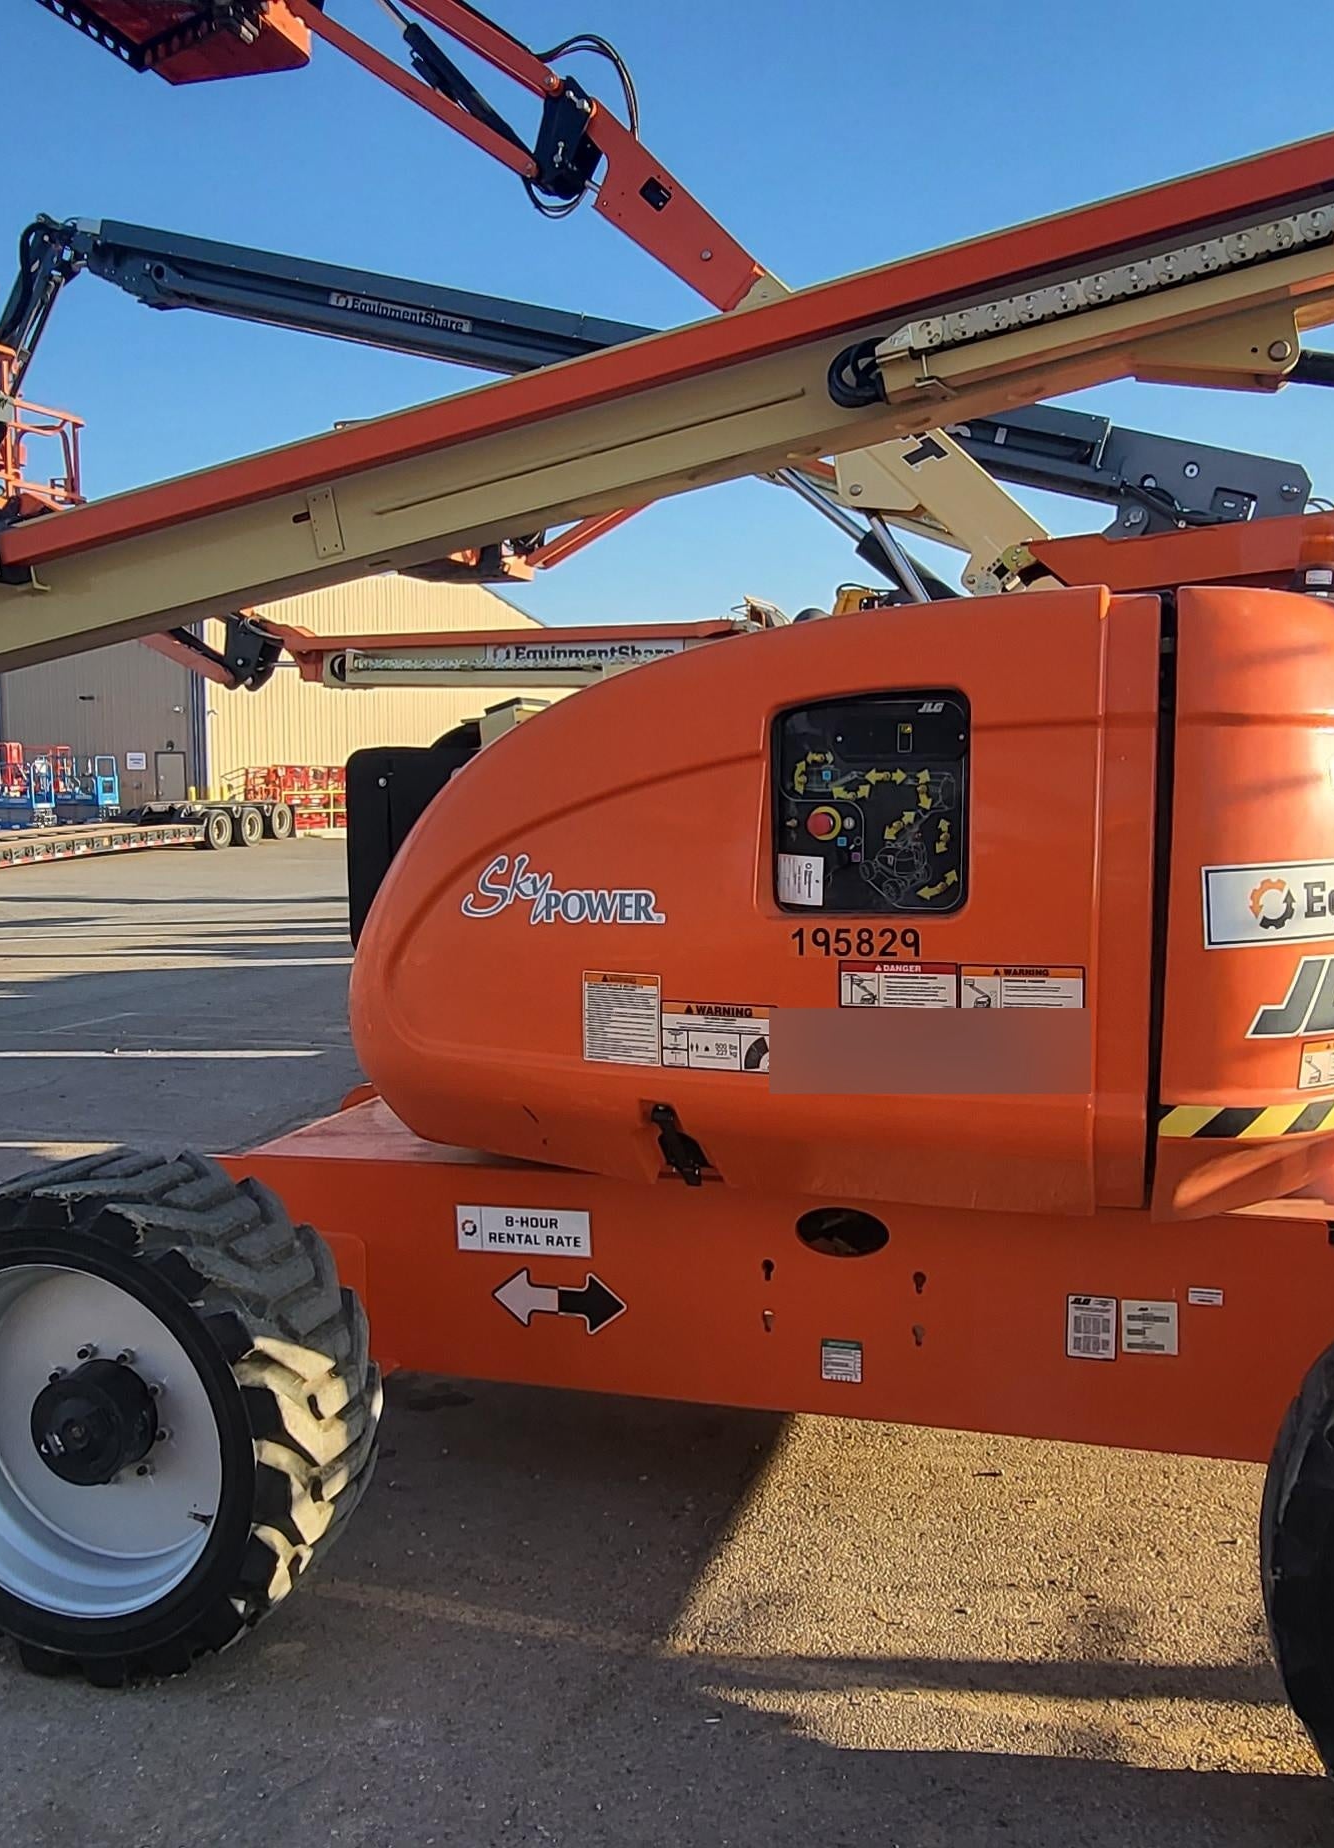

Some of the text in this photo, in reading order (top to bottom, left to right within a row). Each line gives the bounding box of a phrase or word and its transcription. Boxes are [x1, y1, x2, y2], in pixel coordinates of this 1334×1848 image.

[917, 702, 945, 713] JLG
[791, 927, 921, 957] 195829
[883, 964, 922, 973] DANGER
[1003, 968, 1050, 977] WARNING
[696, 1005, 753, 1017] WARNING
[505, 1215, 559, 1229] 8-HOUR
[488, 1232, 582, 1248] RENTAL RATE
